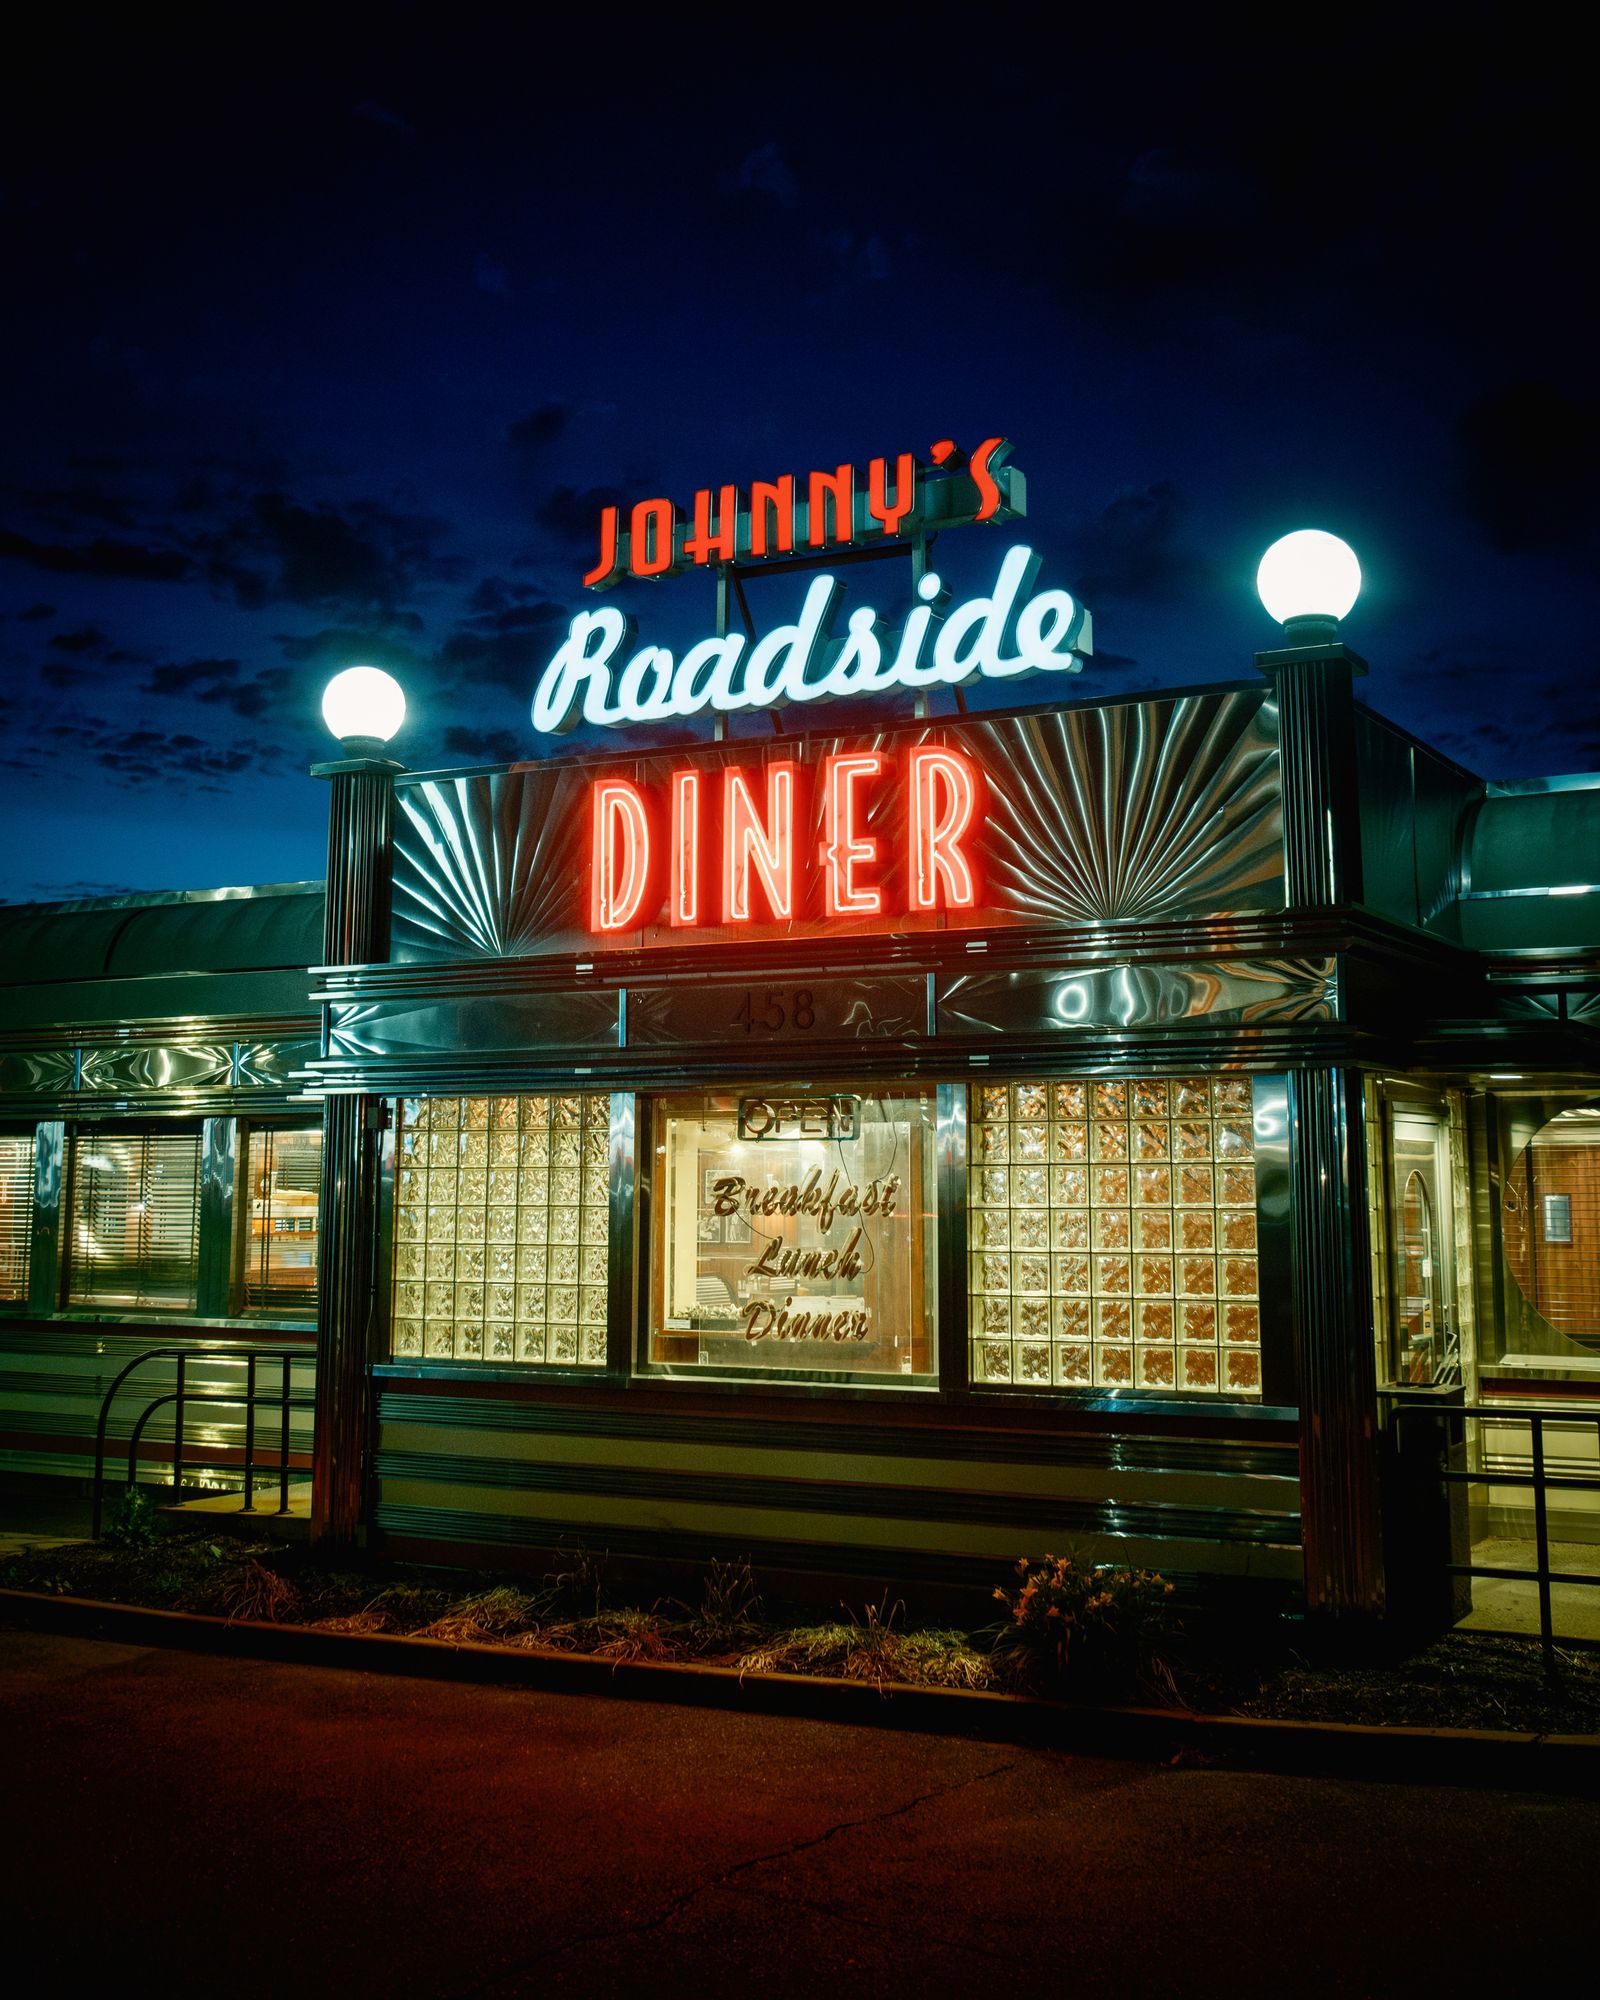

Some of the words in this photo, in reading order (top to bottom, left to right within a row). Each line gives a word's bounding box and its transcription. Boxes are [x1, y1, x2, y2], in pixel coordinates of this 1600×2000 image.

[582, 436, 1010, 588] JOHNNY'S
[530, 545, 1078, 734] Roadside
[590, 745, 977, 932] DINER
[734, 989, 816, 1033] 458
[743, 1100, 853, 1135] OPEN
[712, 1163, 900, 1235] Breakfast
[746, 1227, 863, 1281] Lunch
[742, 1296, 869, 1341] Dinner
